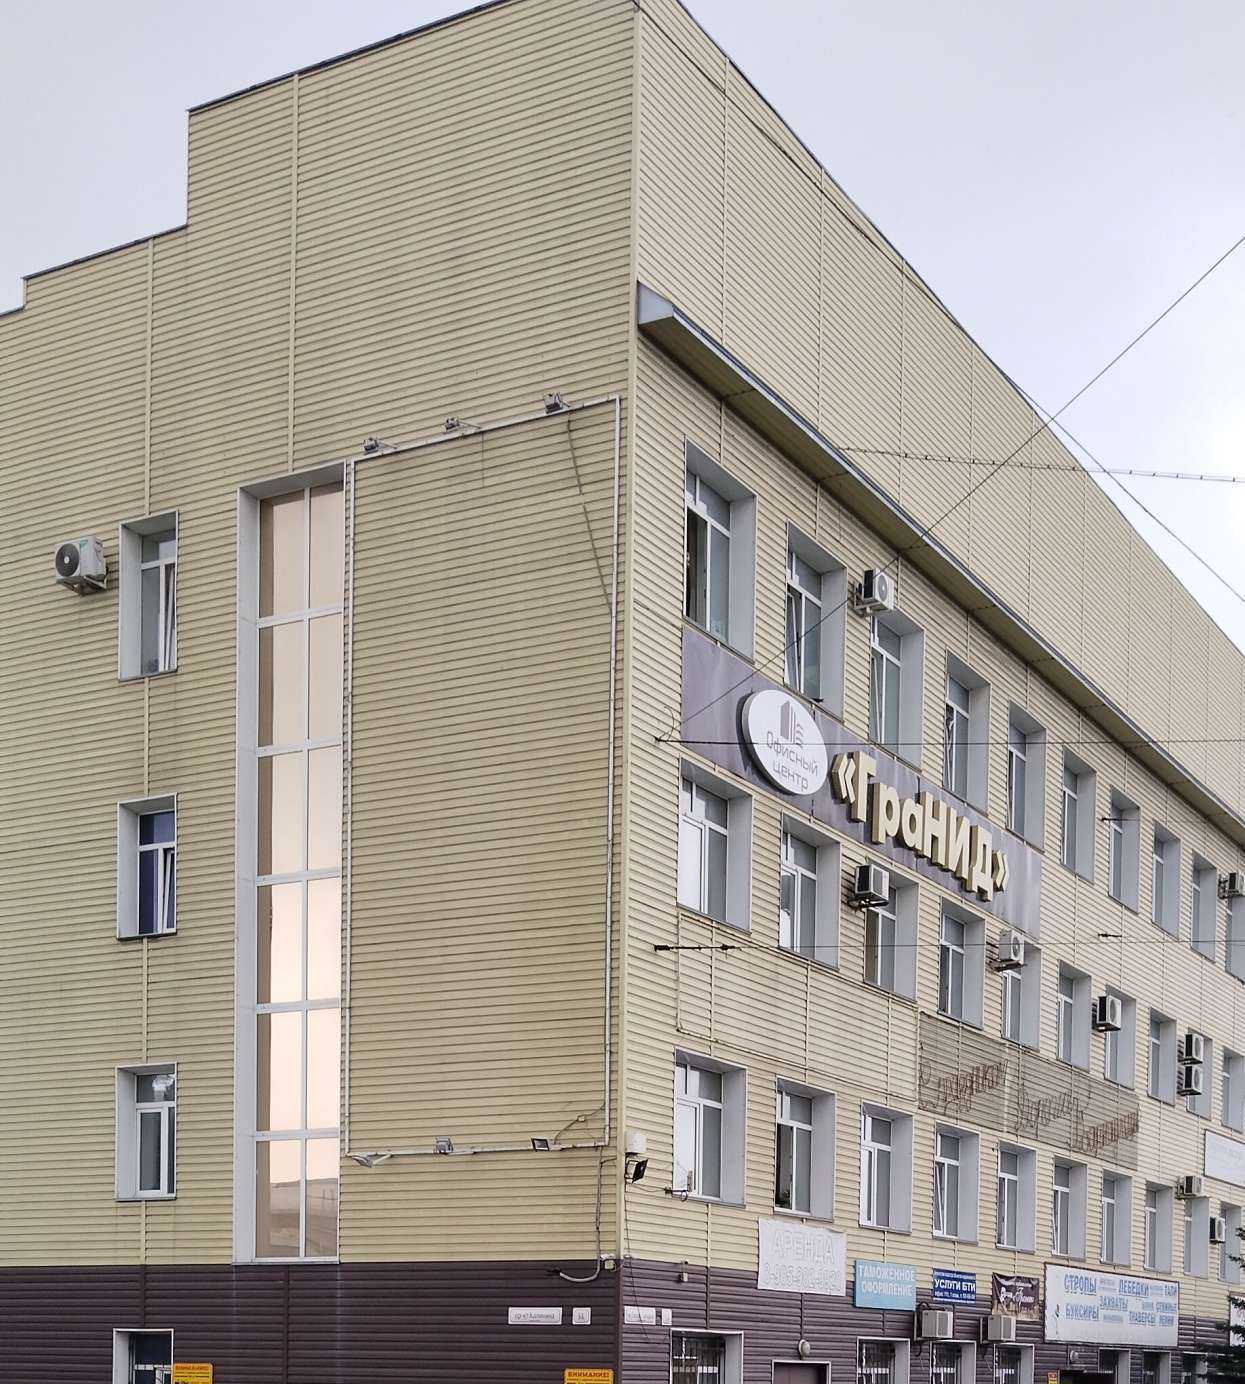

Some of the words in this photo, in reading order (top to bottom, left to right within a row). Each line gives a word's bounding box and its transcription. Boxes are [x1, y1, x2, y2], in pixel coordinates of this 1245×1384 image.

[773, 1229, 835, 1264] АРЕНДА
[858, 1264, 915, 1282] ТАМОЖЕННОЕ
[861, 1281, 913, 1297] ОФОРМЛЕНИЕ
[934, 1278, 961, 1291] УСЛУГИ
[962, 1282, 976, 1292] БТИ
[1064, 1272, 1097, 1294] СТРОПЫ
[1118, 1279, 1150, 1297] ЛЕБЕДКИ
[1065, 1303, 1099, 1320] БУКСИРЫ
